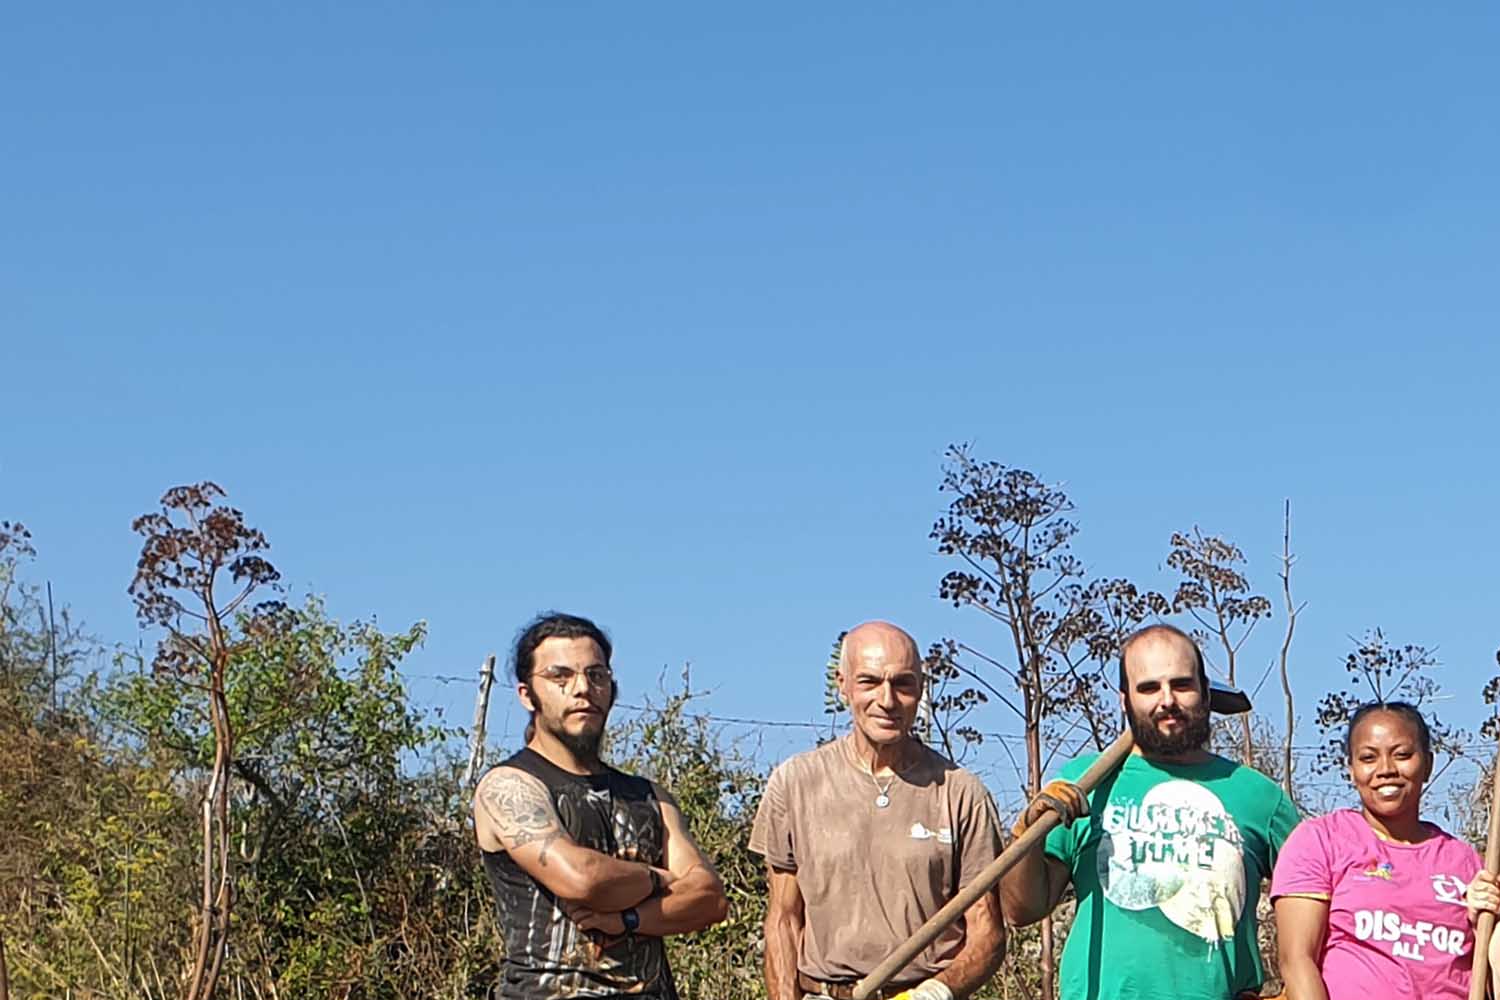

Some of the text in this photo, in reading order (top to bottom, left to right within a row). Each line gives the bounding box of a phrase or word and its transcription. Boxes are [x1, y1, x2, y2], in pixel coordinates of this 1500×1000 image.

[1103, 802, 1244, 843] SUMMER
[1129, 832, 1214, 867] TIME
[1391, 941, 1425, 961] ALL
